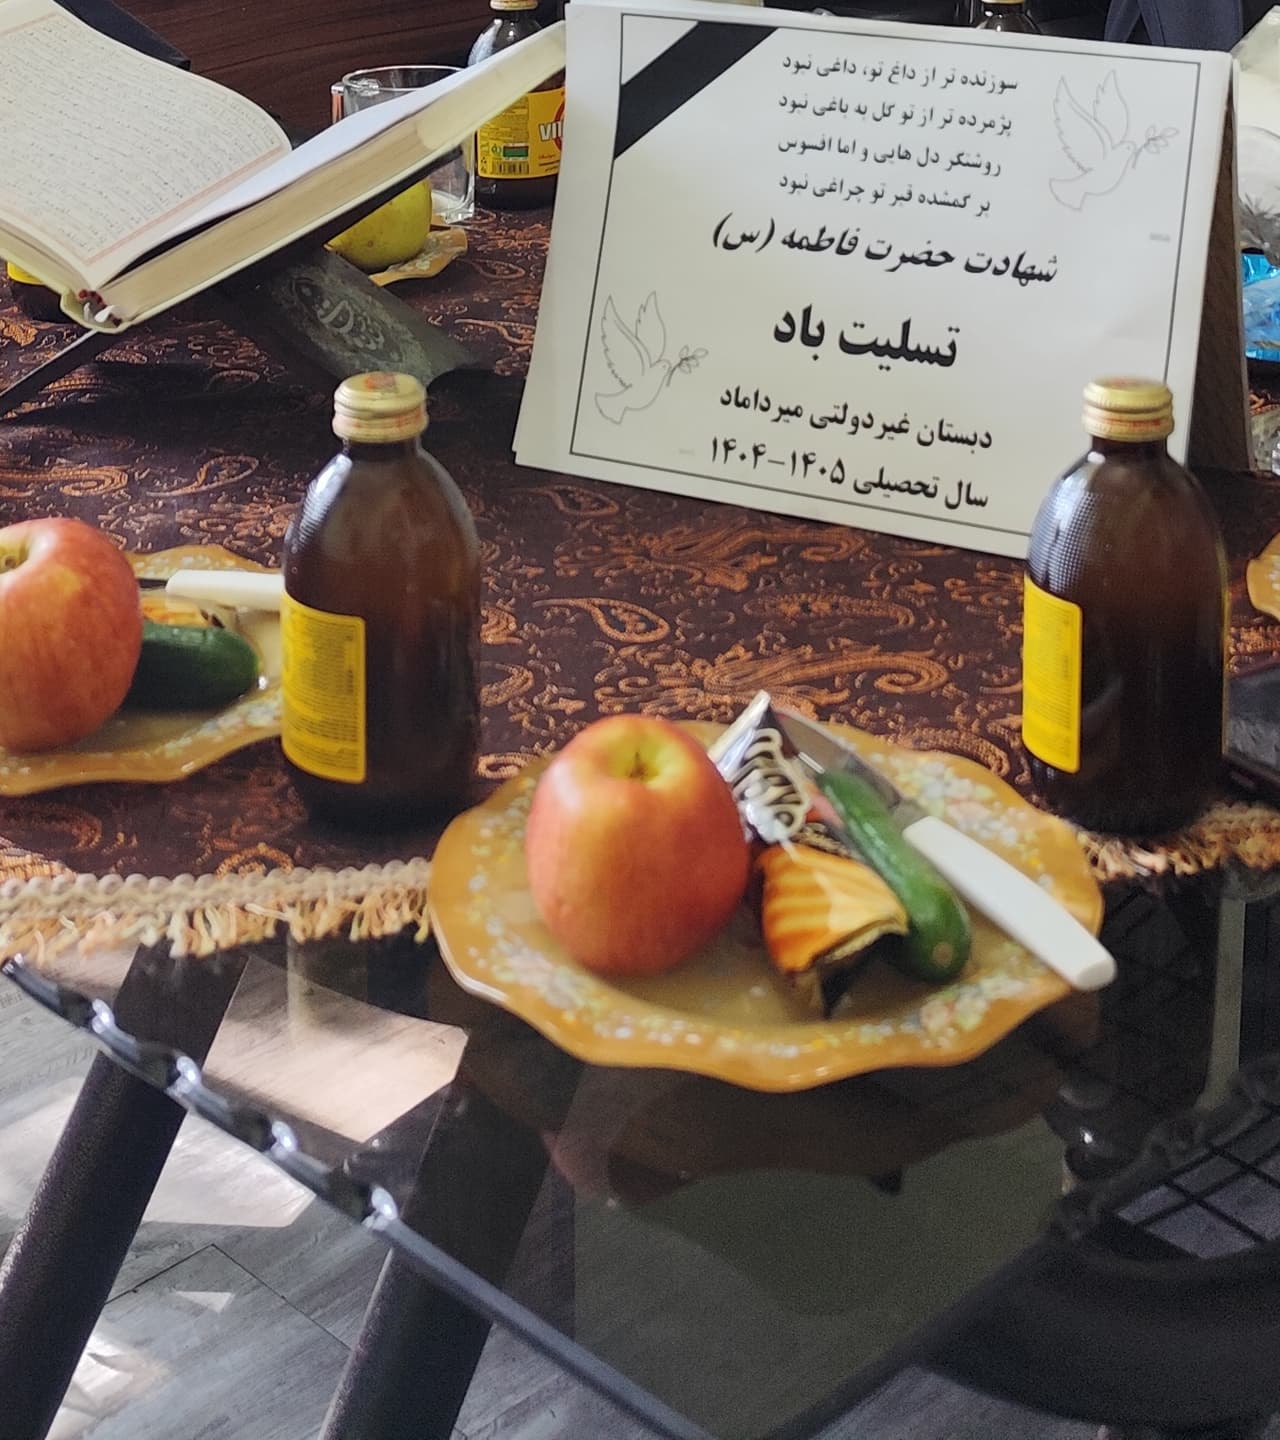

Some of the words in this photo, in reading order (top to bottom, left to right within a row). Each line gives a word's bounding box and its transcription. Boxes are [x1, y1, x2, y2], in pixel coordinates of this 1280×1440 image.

[782, 54, 812, 74] نبود
[816, 57, 857, 77] داغی
[863, 61, 883, 82] تو،
[888, 61, 916, 84] داغ
[921, 67, 936, 87] از
[941, 67, 955, 89] تر
[961, 70, 1017, 94] سوزنده
[778, 93, 808, 114] نبود
[812, 98, 849, 120] باغی
[854, 105, 868, 121] به
[900, 104, 914, 126] تو
[918, 107, 934, 127] از
[937, 108, 953, 129] تر
[958, 115, 1012, 137] پژمرده
[777, 133, 832, 155] افسوس
[837, 138, 856, 154] اما
[861, 147, 869, 162] و
[873, 144, 912, 165] هایی
[916, 147, 940, 168] دل
[779, 174, 809, 194] نبود
[812, 177, 865, 203] چراغی
[870, 182, 886, 204] تو
[891, 183, 913, 207] قبر
[975, 199, 991, 217] بر
[713, 212, 776, 254] (س)
[781, 226, 861, 256] فاطمه
[865, 239, 955, 272] حضرت
[963, 251, 1059, 287] شهادت
[773, 304, 825, 361] باد
[838, 317, 961, 372] تسلیت
[720, 386, 803, 423] میرداماد
[917, 418, 992, 454] دبستان
[853, 467, 939, 498] تحصیلی
[944, 479, 989, 509] سال
